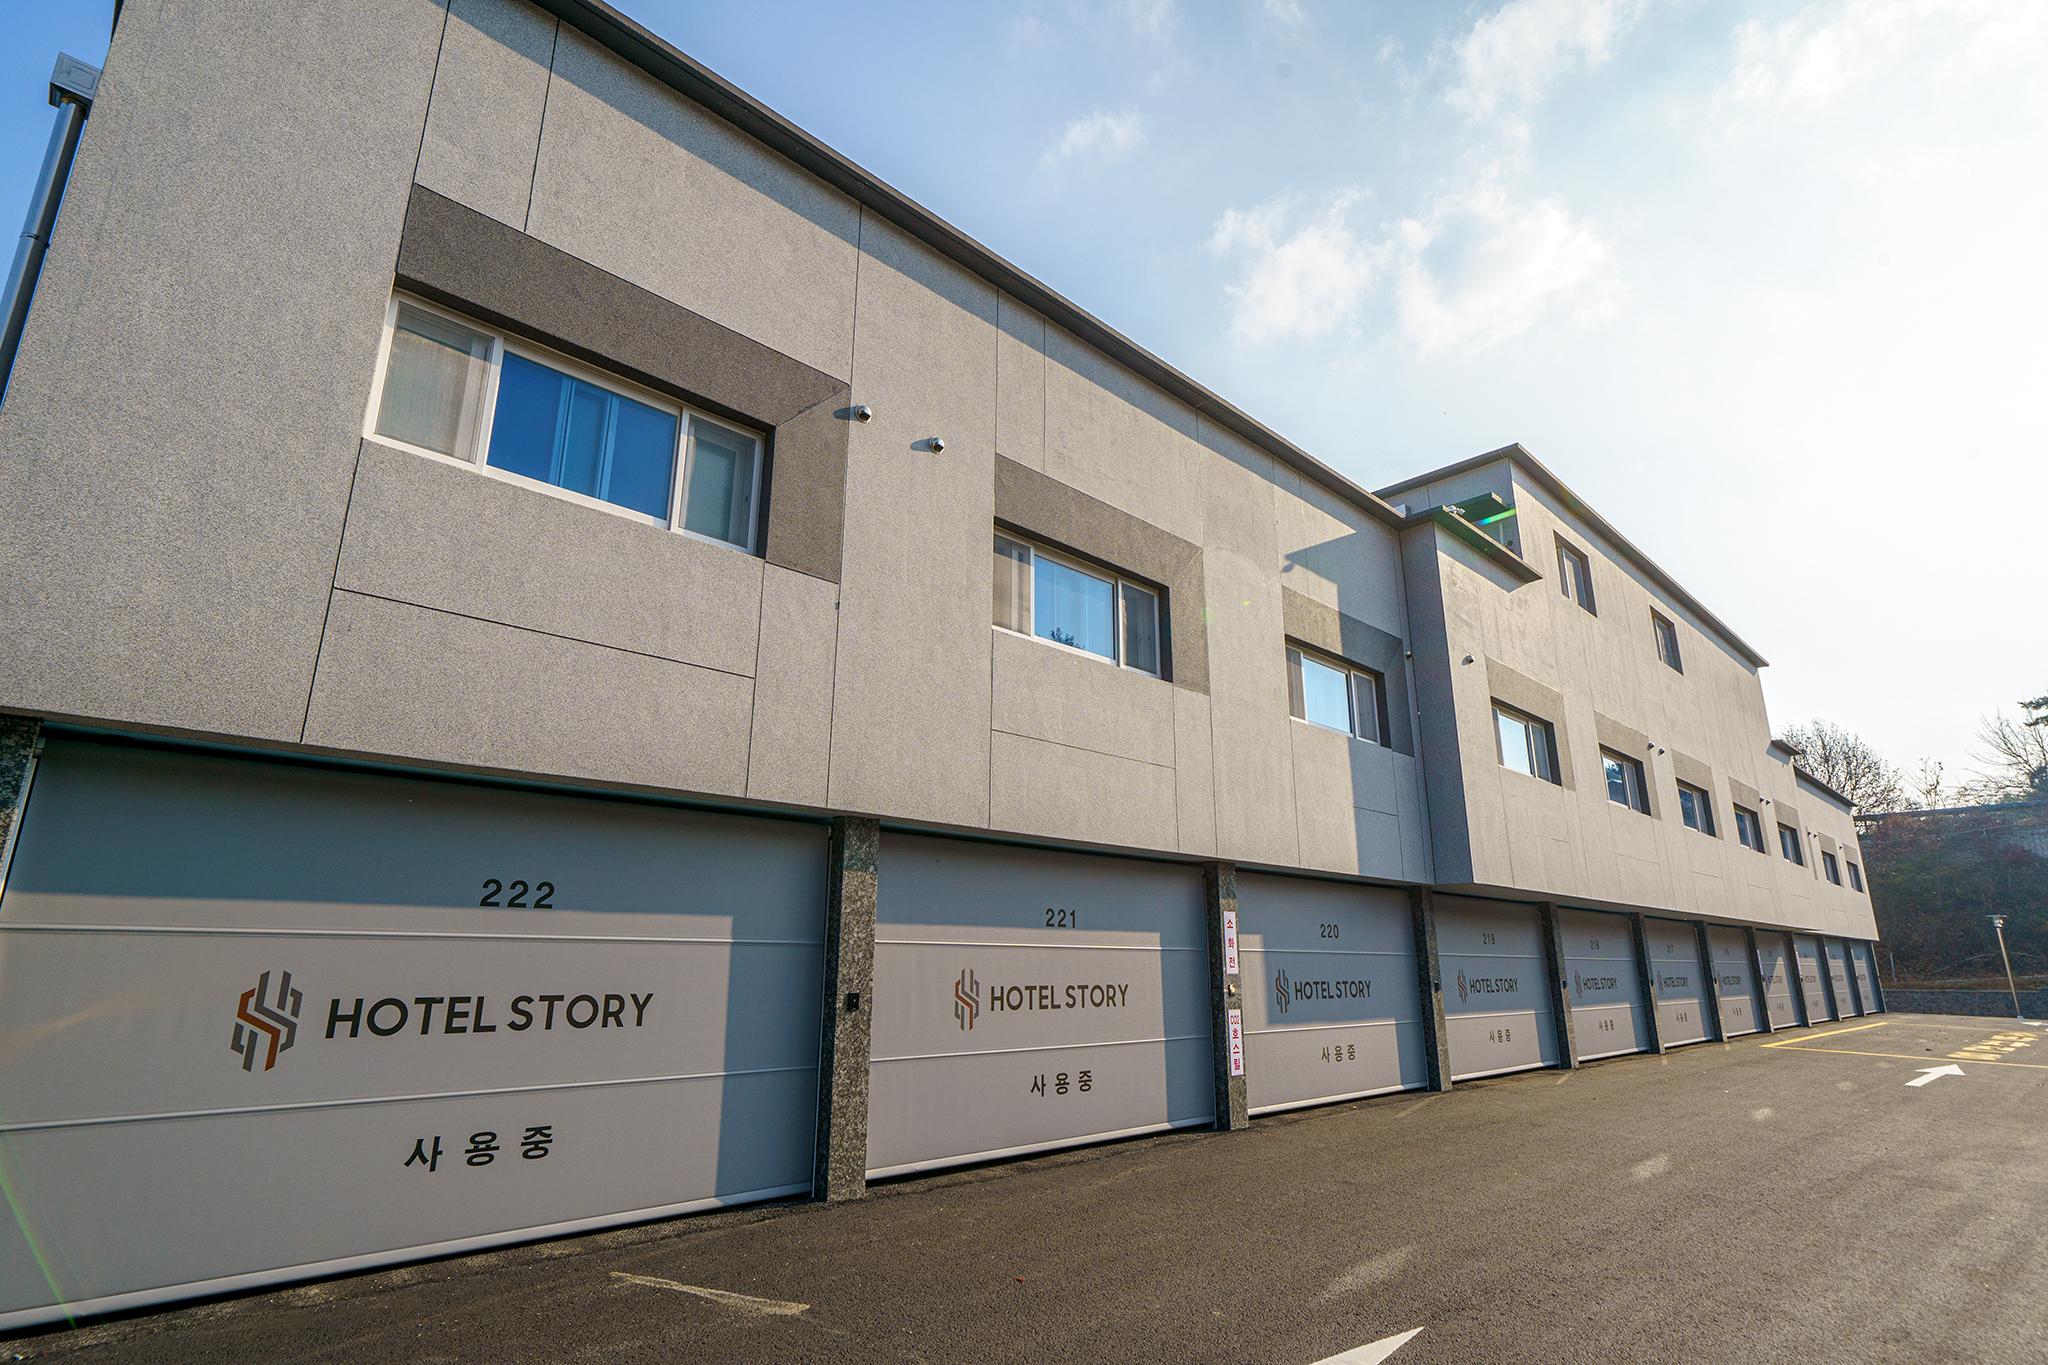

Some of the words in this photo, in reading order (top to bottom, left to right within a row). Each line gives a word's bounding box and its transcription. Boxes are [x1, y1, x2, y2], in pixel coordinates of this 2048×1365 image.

[480, 878, 555, 910] 222
[1045, 908, 1077, 929] 221
[1320, 923, 1340, 939] 220
[1294, 980, 1334, 1001] HOTEL
[1336, 979, 1371, 999] STORY
[1469, 977, 1495, 994] HOTEL
[1495, 977, 1519, 993] STORY
[1583, 977, 1600, 990] HOTEL
[1600, 977, 1617, 990] STORY
[990, 984, 1061, 1012] HOTEL
[1065, 983, 1129, 1009] STORY
[325, 995, 498, 1039] HOTEL
[508, 992, 654, 1032] STORY
[1321, 1044, 1356, 1064] 사용중
[1030, 1070, 1093, 1098] 사용중
[403, 1125, 555, 1173] 사용중
